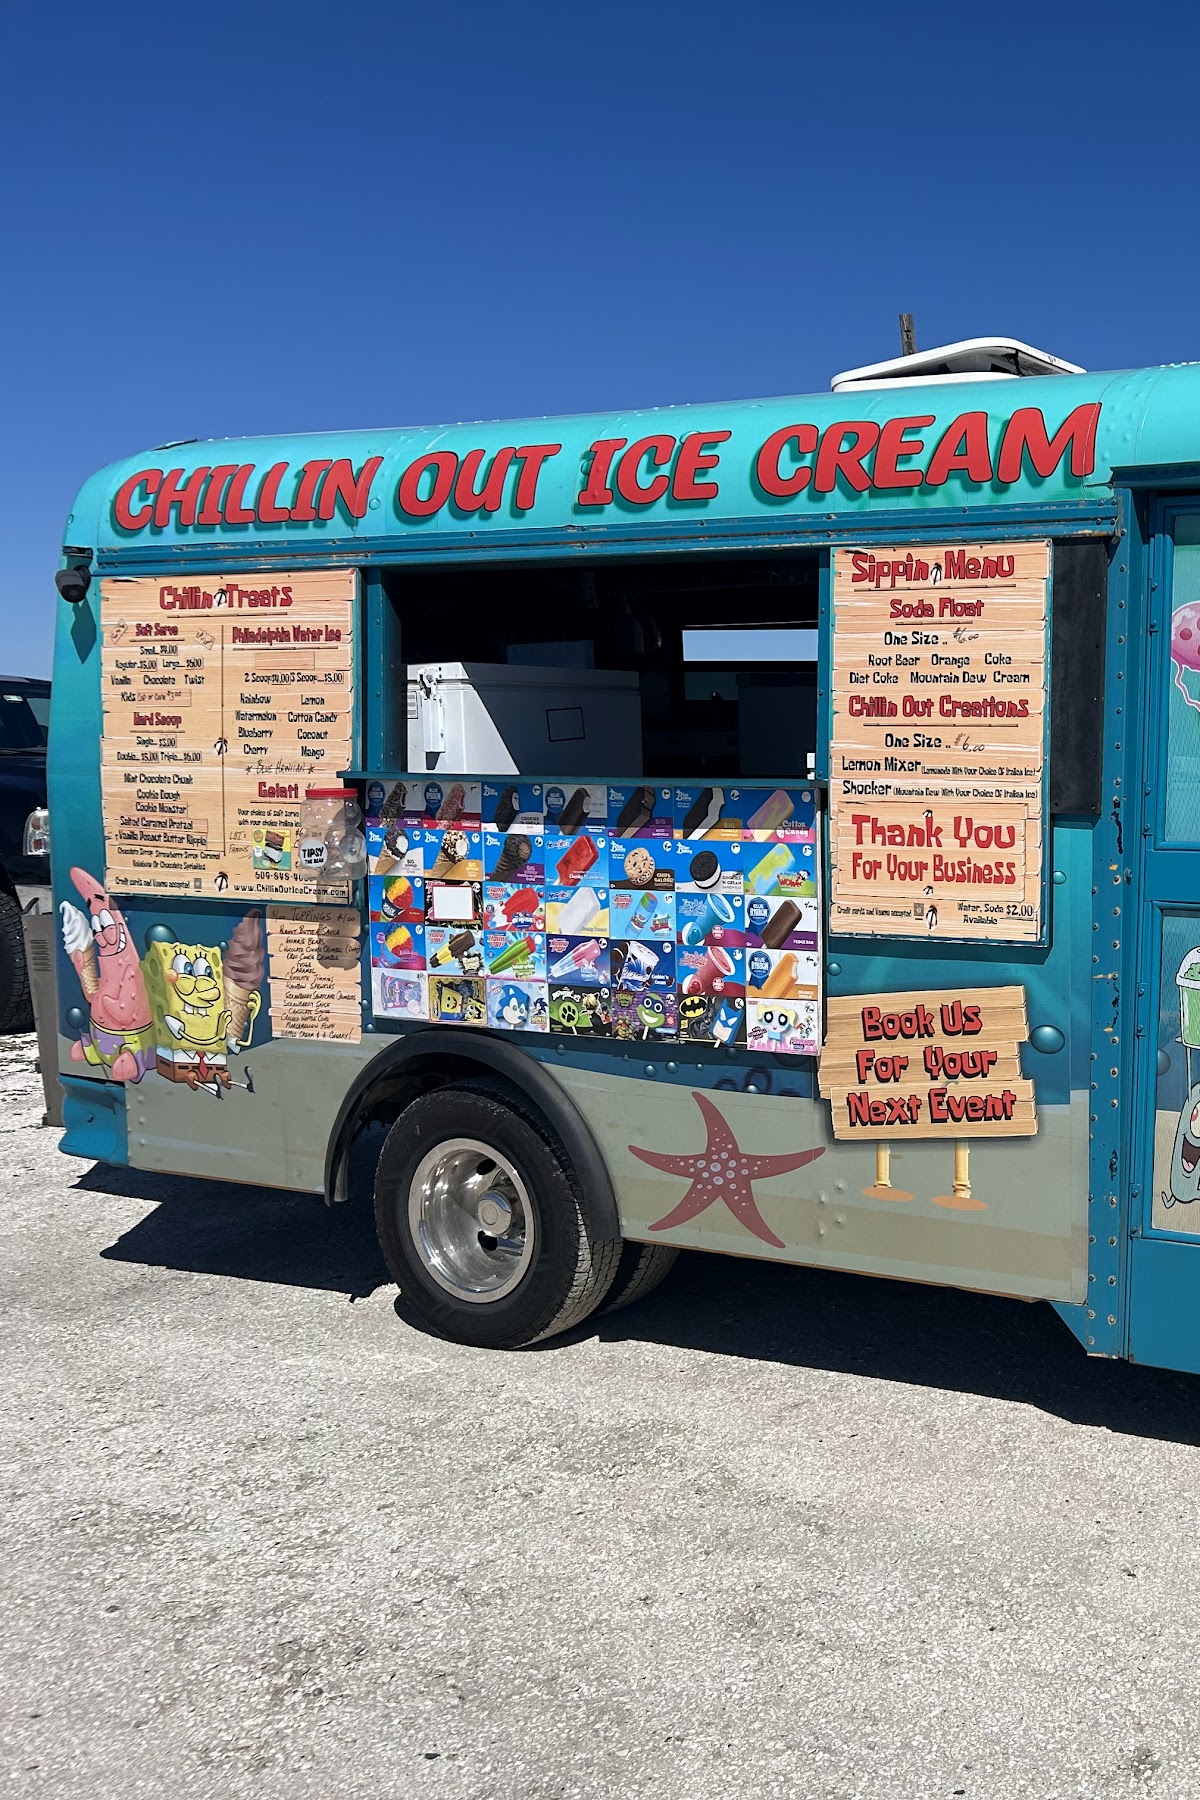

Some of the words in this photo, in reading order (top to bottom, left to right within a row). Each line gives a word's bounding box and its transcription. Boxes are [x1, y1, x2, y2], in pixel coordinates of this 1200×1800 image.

[114, 456, 384, 530] CHILLIN
[400, 444, 561, 517] OUT
[578, 430, 732, 506] ICE
[757, 403, 1102, 496] CREAM
[852, 552, 929, 588] Sippin
[944, 550, 1015, 580] Menu
[160, 586, 213, 610] Chillin
[226, 584, 293, 608] Treats
[890, 599, 934, 619] Soda
[939, 598, 984, 617] Float
[136, 624, 153, 636] Soft
[154, 623, 178, 636] Serve
[233, 627, 290, 646] Philadelphia
[293, 625, 323, 642] Water
[325, 625, 341, 641] Ice
[884, 632, 907, 646] One
[912, 631, 939, 645] Size
[869, 654, 893, 666] Root
[895, 655, 920, 666] Beer
[931, 654, 970, 668] Orange
[985, 653, 1012, 665] Coke
[111, 675, 131, 685] Vanilla
[143, 675, 175, 685] Chocolate
[185, 675, 205, 684] Twist
[245, 673, 249, 682] 2
[297, 672, 317, 684] Scoop
[850, 672, 869, 684] Diet
[873, 672, 898, 684] Coke
[910, 672, 959, 684] Mountain
[962, 672, 987, 683] Dew
[993, 671, 1030, 684] Cream
[121, 692, 136, 701] Kids
[240, 693, 271, 704] Rainbow
[301, 694, 325, 705] Lemon
[850, 696, 897, 717] Chillin
[902, 695, 934, 717] Out
[940, 696, 1029, 717] Creations
[134, 712, 153, 725] Hard
[155, 712, 182, 728] Scoop
[235, 710, 276, 721] Watermelon
[288, 712, 313, 722] Cotton
[315, 712, 337, 722] Candy
[238, 727, 273, 738] Blueberry
[297, 729, 328, 739] Coconut
[885, 733, 909, 748] One
[913, 733, 942, 748] Size
[244, 744, 268, 754] Cherry
[301, 746, 324, 759] Mango
[842, 756, 880, 771] Lemon
[884, 757, 921, 772] Mixer
[139, 773, 171, 784] Chocolate
[173, 774, 193, 784] Chunk
[137, 789, 159, 799] Cookie
[161, 790, 180, 801] Dough
[258, 782, 298, 798] Gelati
[843, 780, 892, 796] Shocker
[925, 788, 939, 796] Dew
[955, 788, 971, 798] Your
[972, 789, 993, 798] Choice
[136, 802, 157, 812] Cookie
[159, 803, 187, 813] Monster
[120, 816, 139, 826] Salted
[141, 818, 167, 828] Caramel
[169, 819, 193, 830] Pretzel
[119, 830, 138, 840] Vanilla
[140, 831, 162, 841] Peanut
[163, 832, 184, 843] Butter
[187, 834, 206, 847] Ripple
[784, 829, 808, 837] Candy
[852, 814, 943, 848] Thank
[953, 816, 1015, 849] You
[302, 847, 324, 858] TIPSY
[852, 852, 882, 880] For
[887, 853, 928, 881] Your
[933, 854, 1016, 884] Business
[292, 908, 331, 922] TOPPINGS
[984, 902, 1003, 912] Soda
[1006, 904, 1033, 917] $2.00
[963, 915, 998, 924] Available
[861, 1004, 935, 1042] Book
[940, 1000, 983, 1036] Us
[856, 1049, 909, 1084] For
[923, 1045, 997, 1080] Your
[847, 1092, 922, 1126] Next
[928, 1087, 1017, 1123] Event
